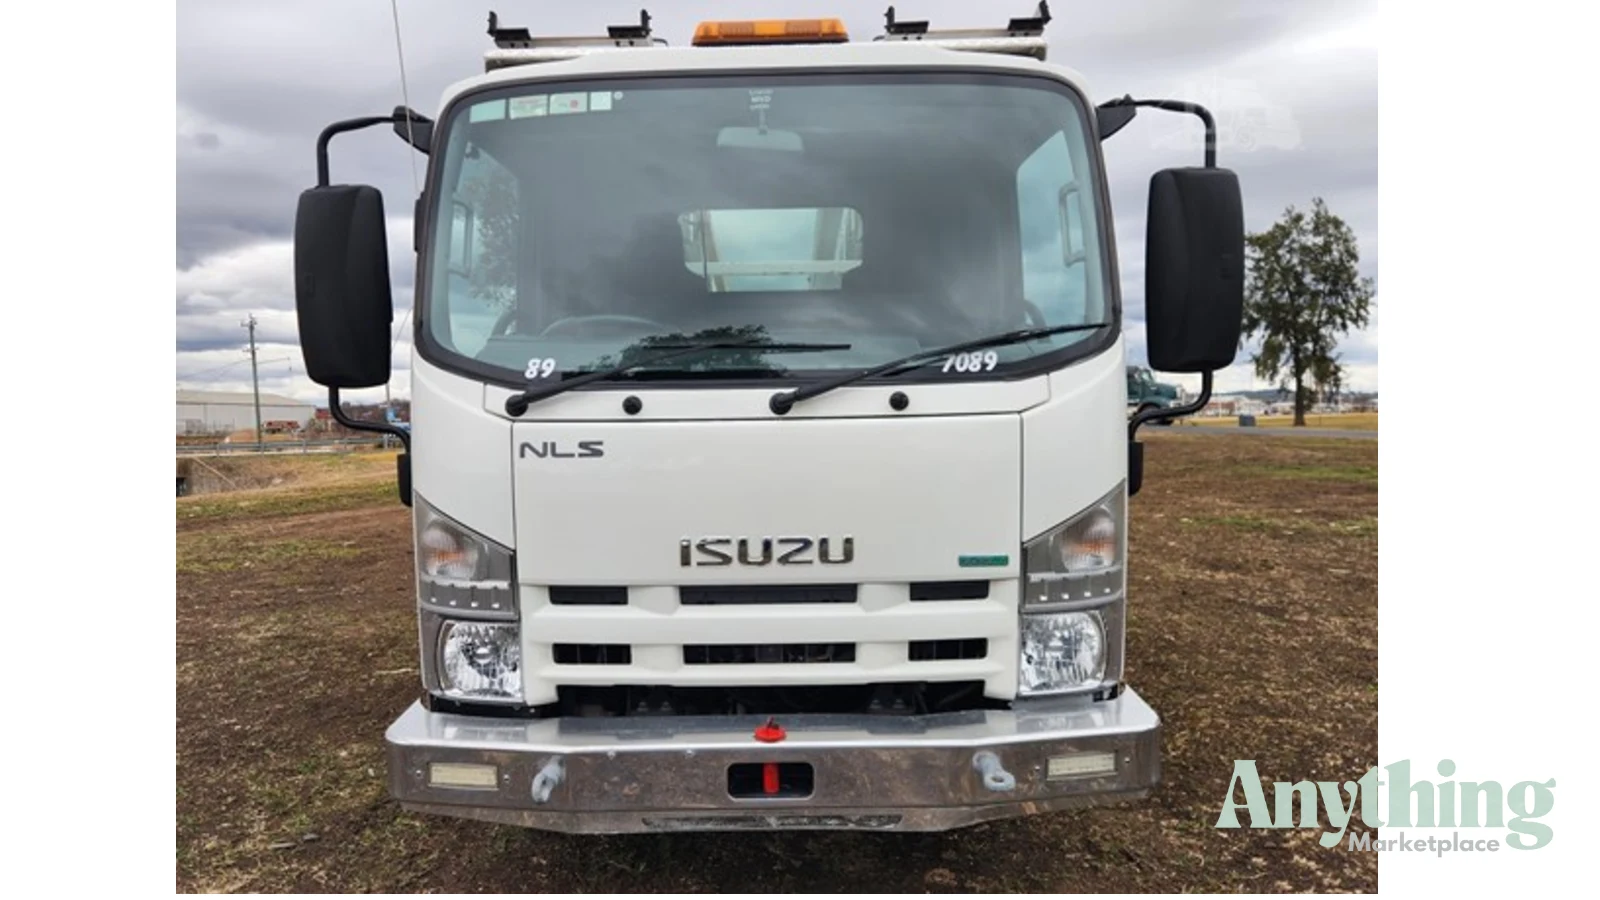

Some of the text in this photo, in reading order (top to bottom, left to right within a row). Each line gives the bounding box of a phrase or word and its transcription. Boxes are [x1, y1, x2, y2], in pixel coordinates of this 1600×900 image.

[525, 358, 556, 379] 89
[941, 351, 998, 373] 7089
[519, 441, 604, 459] NLS
[680, 536, 854, 567] ISUZU
